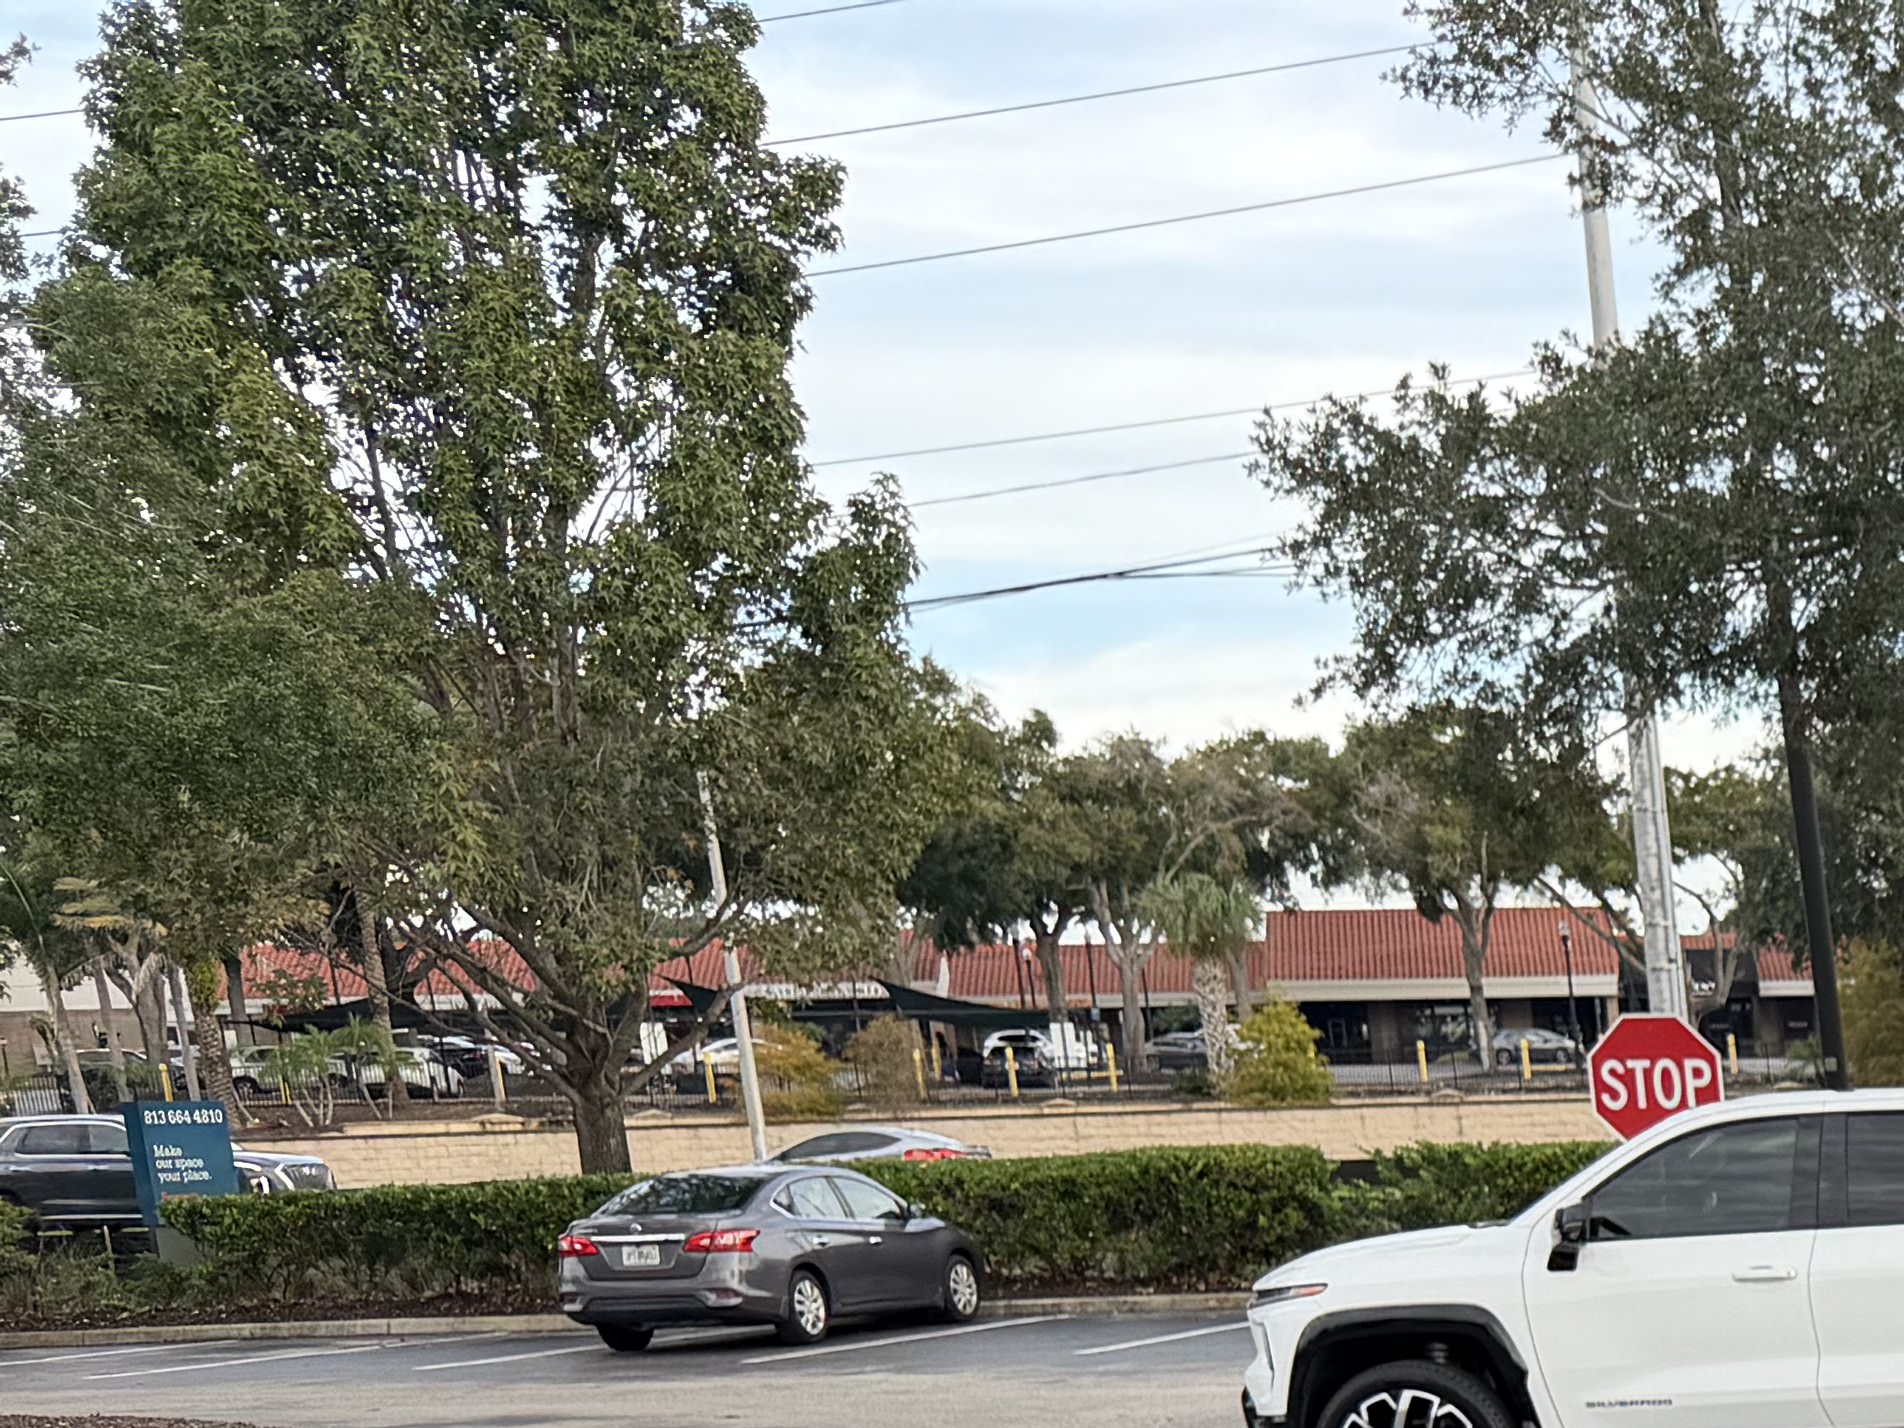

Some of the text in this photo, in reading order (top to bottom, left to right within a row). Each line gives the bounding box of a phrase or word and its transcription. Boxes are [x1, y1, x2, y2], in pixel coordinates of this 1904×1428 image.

[1600, 1058, 1712, 1111] STOP
[144, 1109, 223, 1125] 813 664 4810
[153, 1144, 183, 1157] Make
